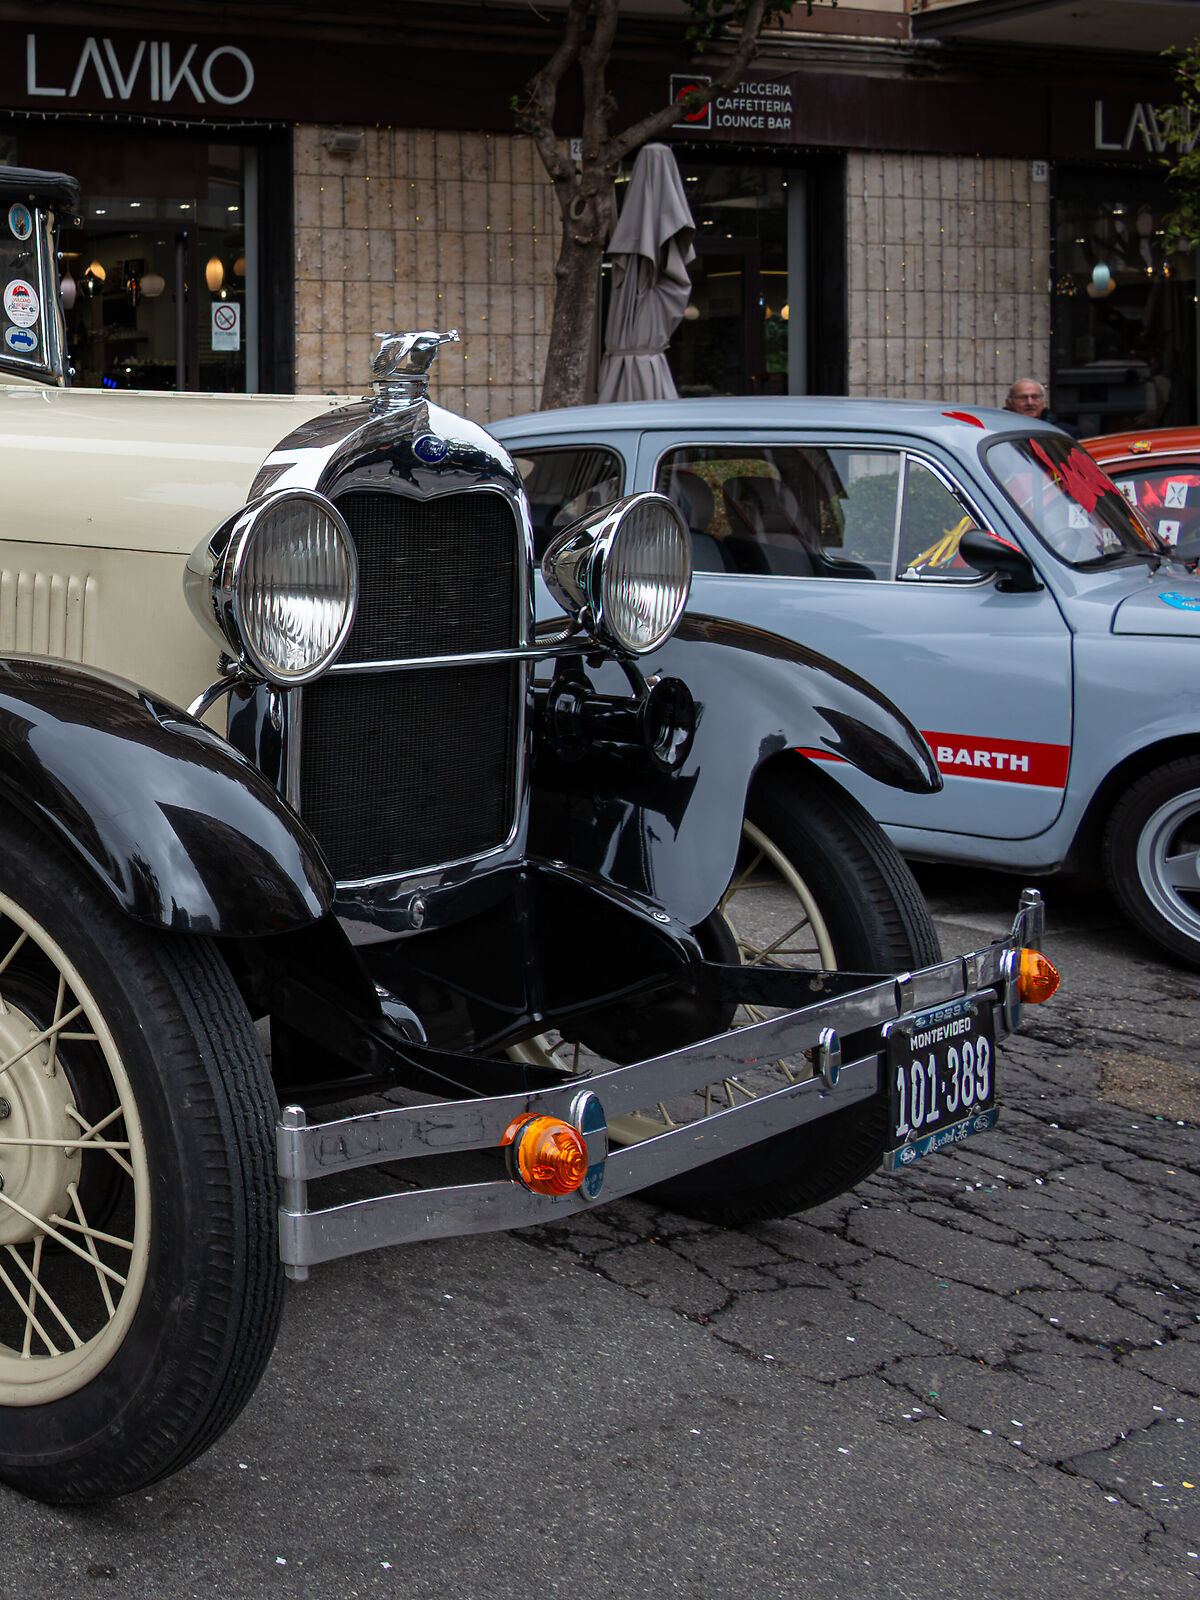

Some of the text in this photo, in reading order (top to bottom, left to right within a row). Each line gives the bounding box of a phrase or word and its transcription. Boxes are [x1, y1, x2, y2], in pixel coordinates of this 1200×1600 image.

[27, 34, 255, 105] LAVIKO
[716, 97, 793, 113] CAFFETTERIA
[716, 115, 792, 130] LOUNGE BAR
[929, 745, 1029, 772] BARTH
[910, 1017, 972, 1051] MONTEVIDEO
